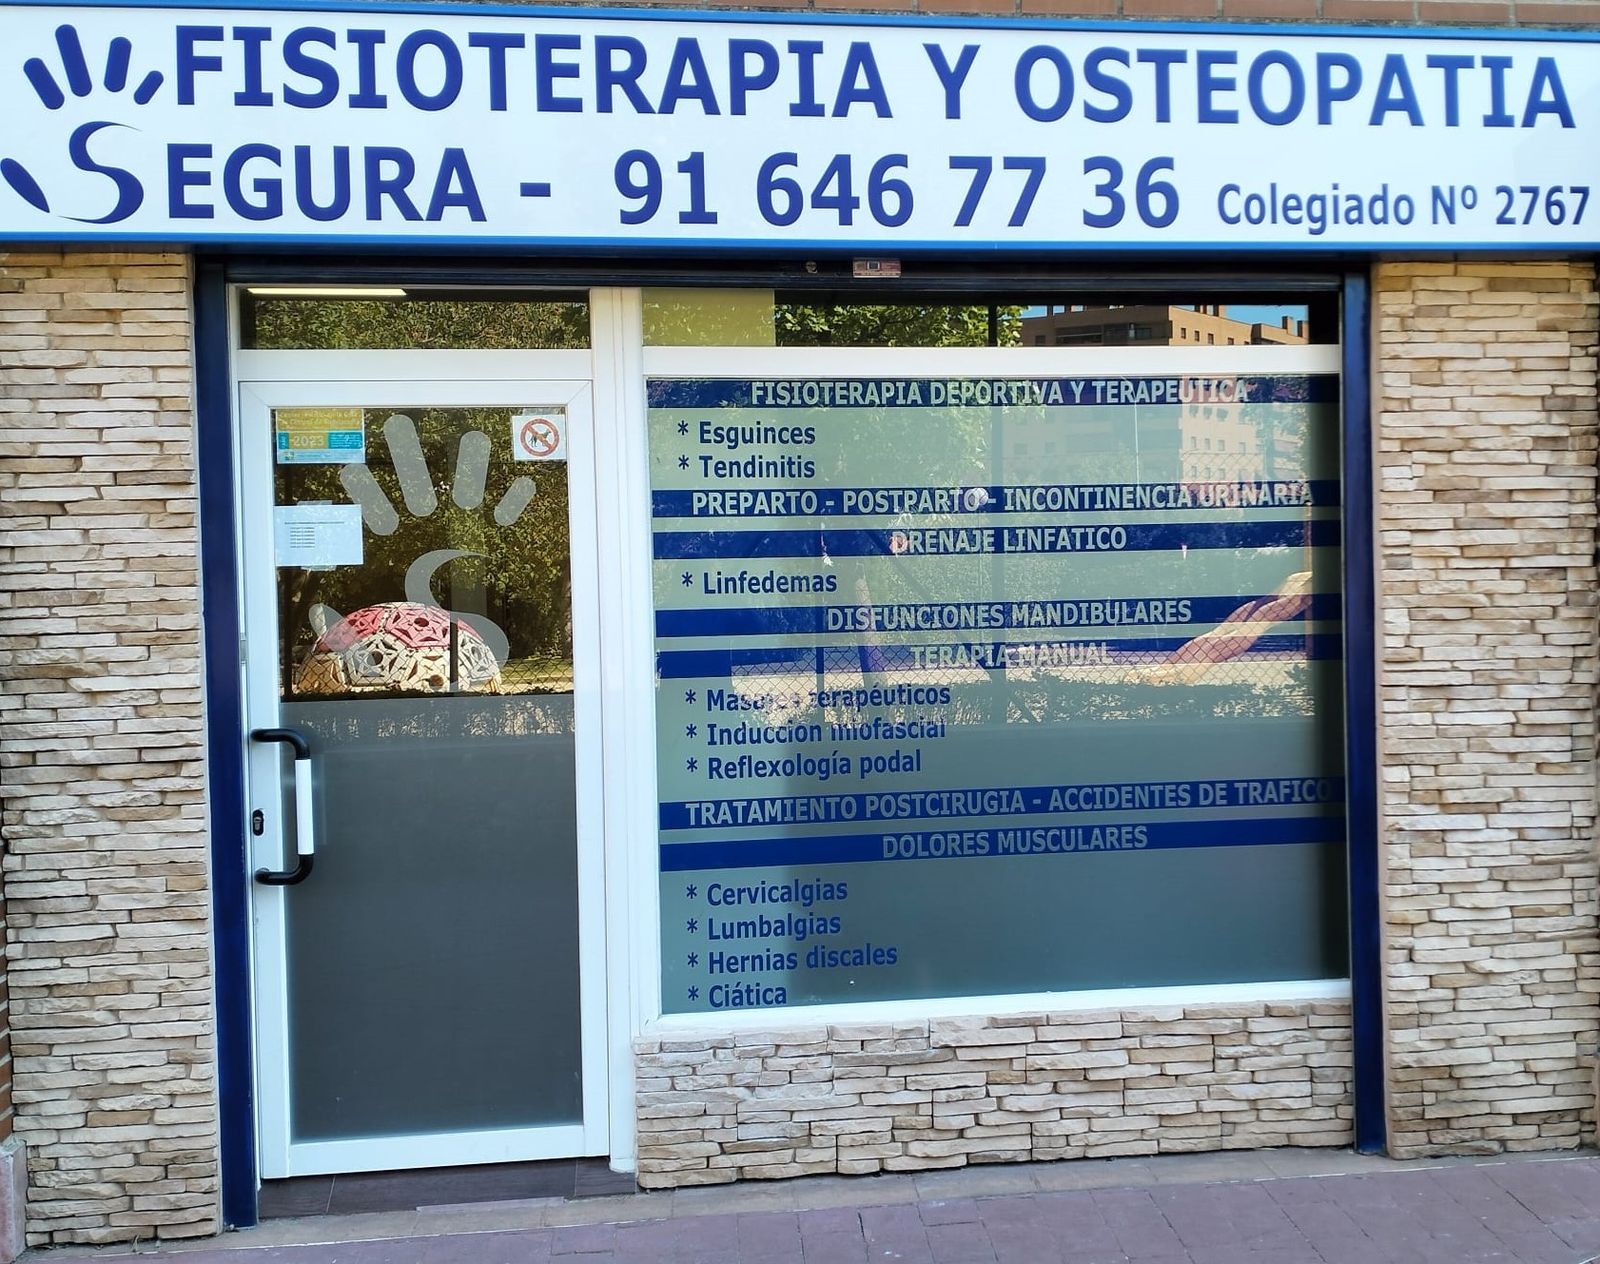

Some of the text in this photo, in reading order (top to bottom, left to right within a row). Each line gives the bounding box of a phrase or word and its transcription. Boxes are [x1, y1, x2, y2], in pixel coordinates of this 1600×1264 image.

[176, 25, 1577, 128] FISIOTERAPIA Y OSTEOPATIA
[57, 121, 487, 224] SEGURA
[614, 149, 718, 225] 91
[757, 152, 914, 227] 646
[948, 156, 1047, 227] 77
[1082, 157, 1180, 228] 36
[1217, 183, 1414, 235] Colegiado
[1432, 186, 1478, 225] Nº
[1496, 185, 1590, 226] 2767
[751, 379, 1249, 405] FISIOTERAPIA DEPORTIVA Y TERAPEUTICA
[699, 421, 816, 449] Esguinces
[699, 455, 816, 478] Tendinitis
[692, 490, 818, 515] PREPARTO
[843, 488, 981, 513] POSTPARTO
[1004, 485, 1192, 511] INCONTINENCIA
[1199, 483, 1312, 507] URINARIA
[891, 526, 1128, 554] DRENAJE LINFATICO
[704, 570, 837, 594] Linfedemas
[827, 599, 1192, 631] DISFUNCIONES MANDIBULARES
[909, 642, 1113, 668] TERAPIA MANUAL
[707, 688, 801, 714] Masa
[831, 717, 946, 741] miofascial
[708, 749, 921, 780] Reflexología podal
[685, 795, 857, 826] TRATAMIENTO
[866, 789, 1026, 818] POSTCIRUGIA
[1049, 783, 1191, 811] ACCIDENTES
[1199, 782, 1228, 805] DE
[1234, 779, 1331, 804] TRAFICO
[882, 825, 1148, 858] DOLORES MUSCULARES
[707, 878, 848, 907] Cervicalgias
[708, 912, 841, 941] Lumbalgias
[709, 943, 897, 974] Hernias discales
[709, 981, 788, 1008] Ciática
